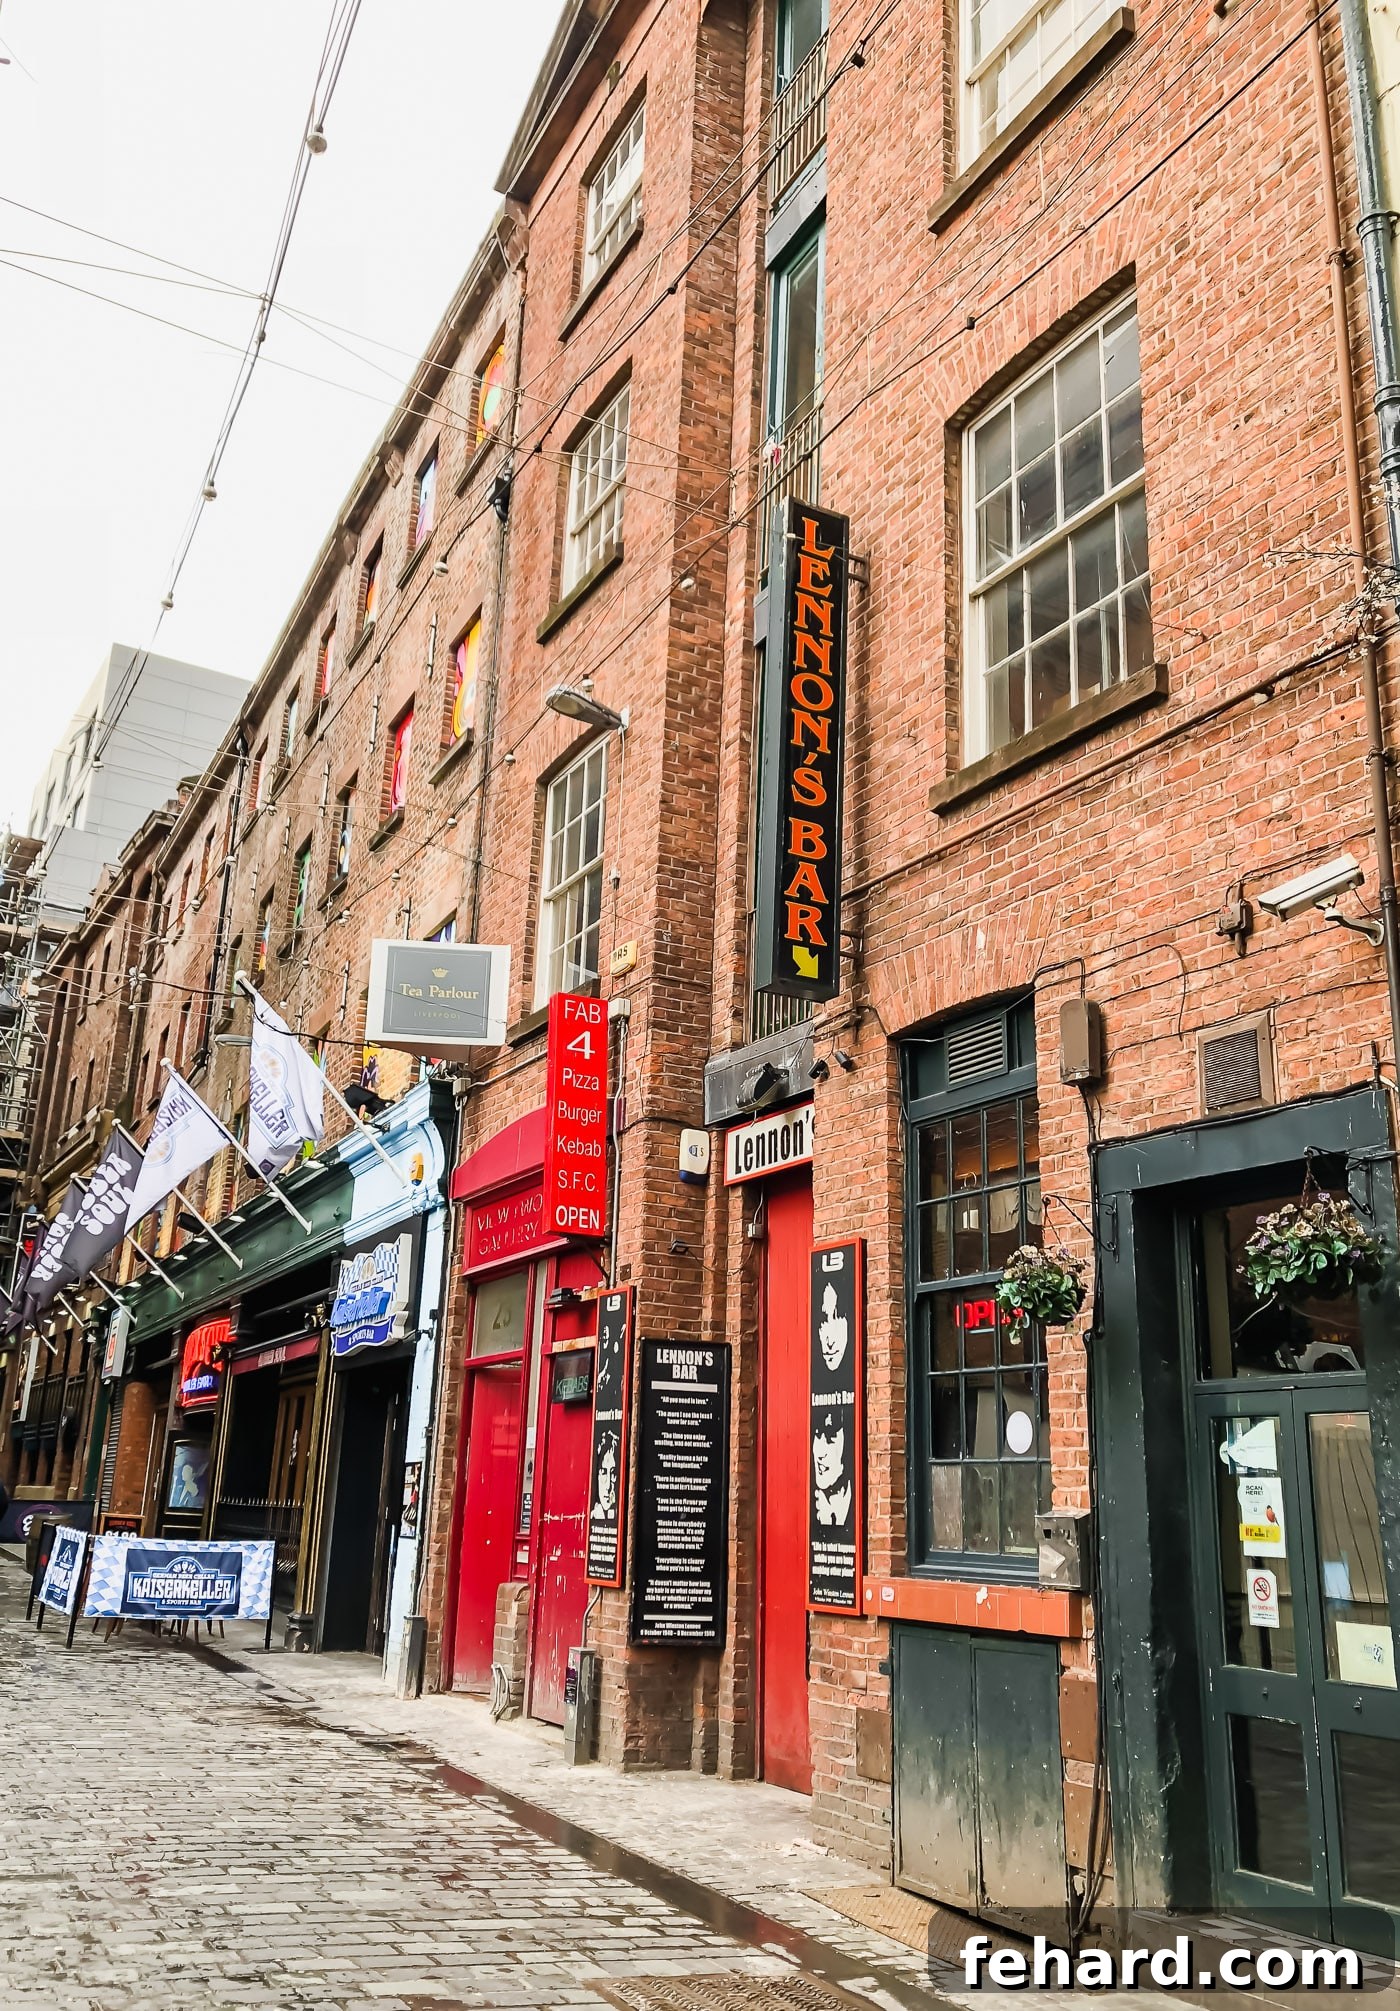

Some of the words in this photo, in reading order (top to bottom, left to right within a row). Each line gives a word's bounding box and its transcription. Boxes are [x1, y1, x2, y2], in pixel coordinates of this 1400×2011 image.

[790, 516, 835, 806] LENNON'S
[784, 816, 829, 946] BAR
[400, 983, 422, 997] Tea
[429, 984, 479, 1000] Parlour
[413, 1010, 461, 1019] LIVERPOOL
[564, 999, 601, 1024] FAB
[566, 1030, 596, 1060] 4
[562, 1067, 600, 1091] Pizza
[558, 1100, 602, 1126] Burger
[557, 1135, 602, 1158] Kebab
[735, 1110, 816, 1175] Lennon'
[558, 1170, 600, 1192] S.F.C.
[555, 1205, 600, 1230] OPEN
[656, 1348, 714, 1366] LENNON'S
[672, 1364, 698, 1380] BAR
[555, 1375, 589, 1396] KEBABS
[812, 1391, 841, 1406] Lennon's
[842, 1390, 854, 1405] Bar
[596, 1409, 615, 1420] Lennon's
[133, 1577, 232, 1599] KAISERKELLER
